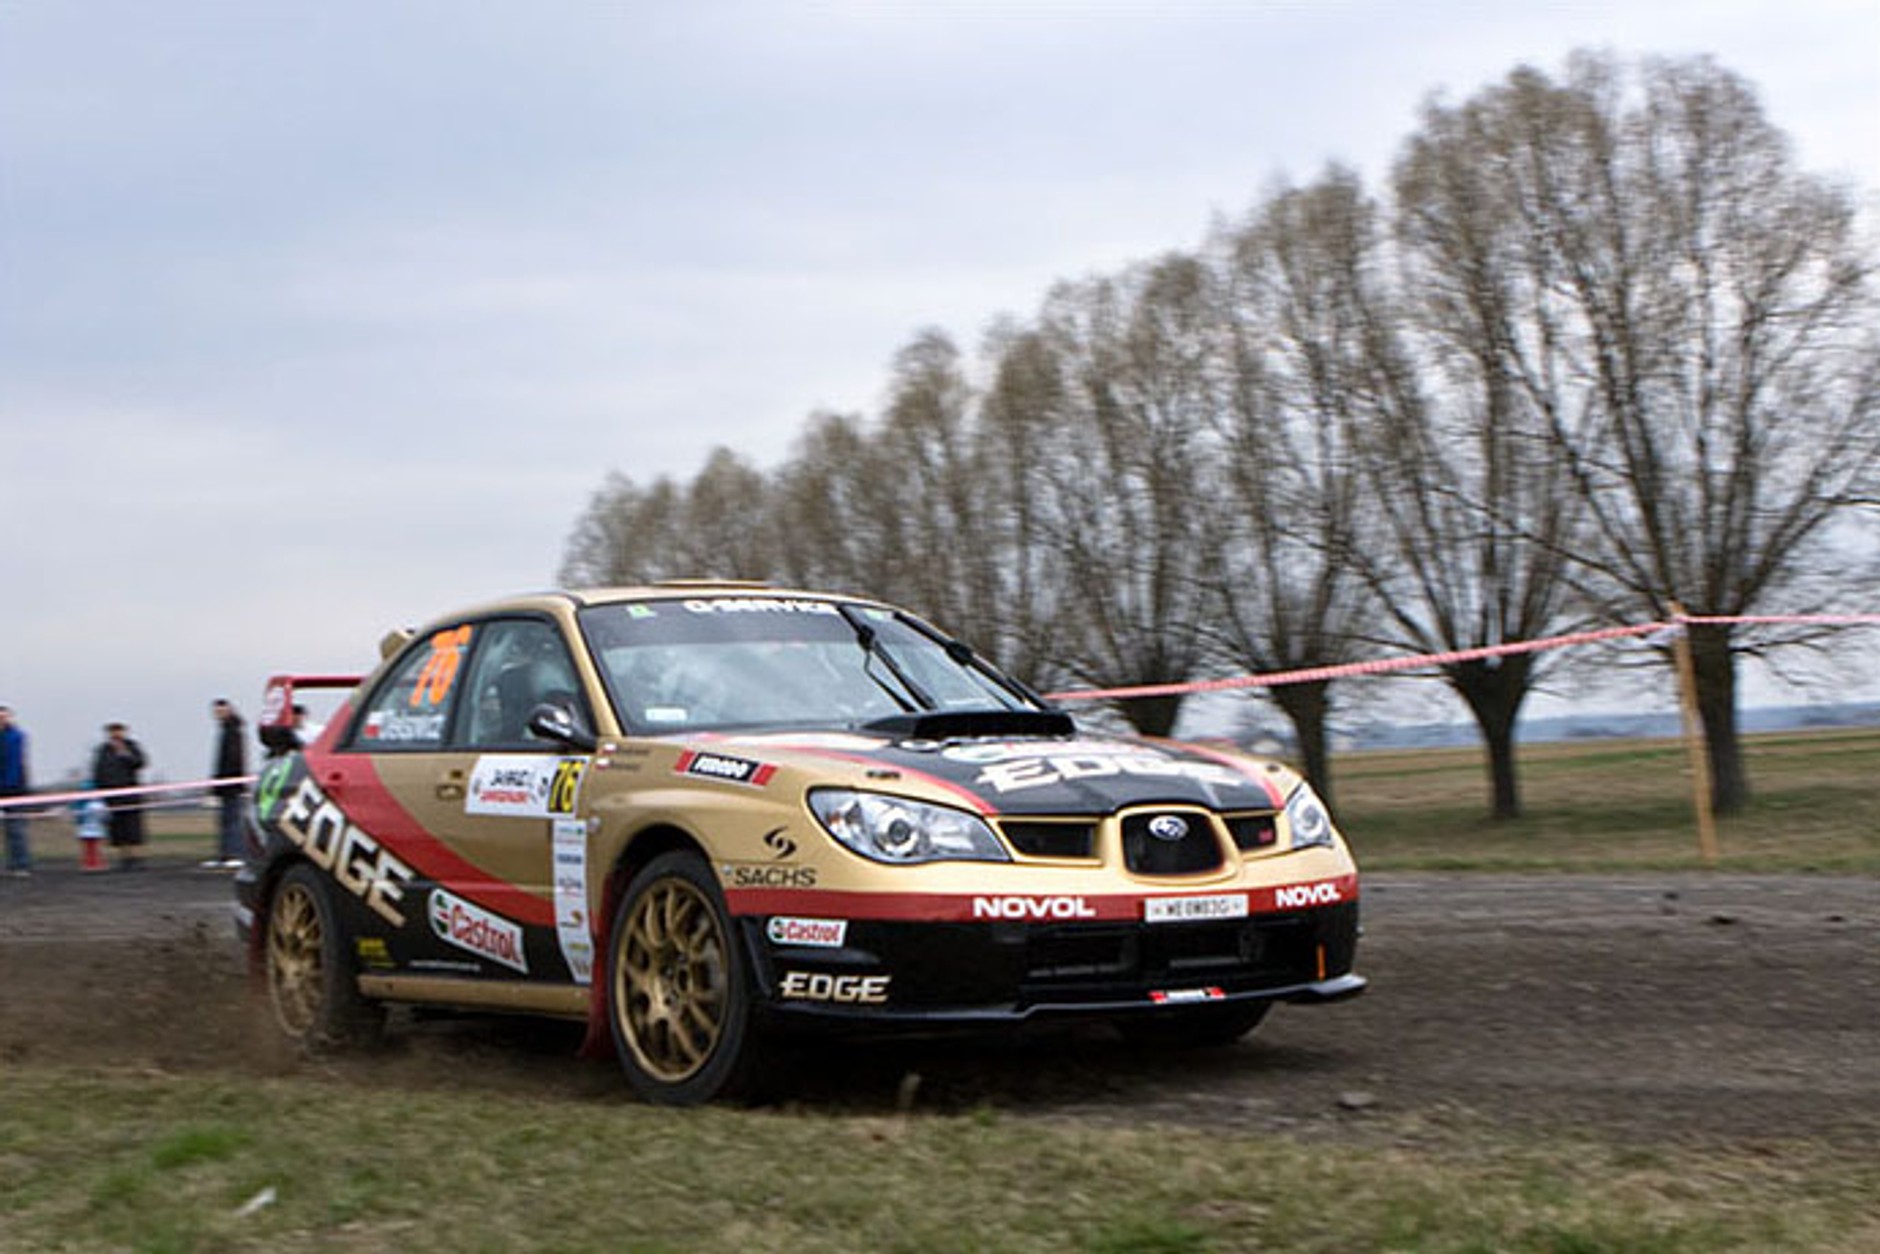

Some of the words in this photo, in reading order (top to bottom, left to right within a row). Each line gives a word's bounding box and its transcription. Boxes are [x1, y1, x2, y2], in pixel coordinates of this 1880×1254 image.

[278, 776, 416, 928] EDGE
[734, 867, 817, 886] SACHS
[1275, 883, 1342, 907] NOVOL
[973, 897, 1096, 918] NOVOL
[451, 903, 523, 966] Castrol
[785, 920, 842, 943] Castrol
[779, 971, 893, 1004] EDGE
